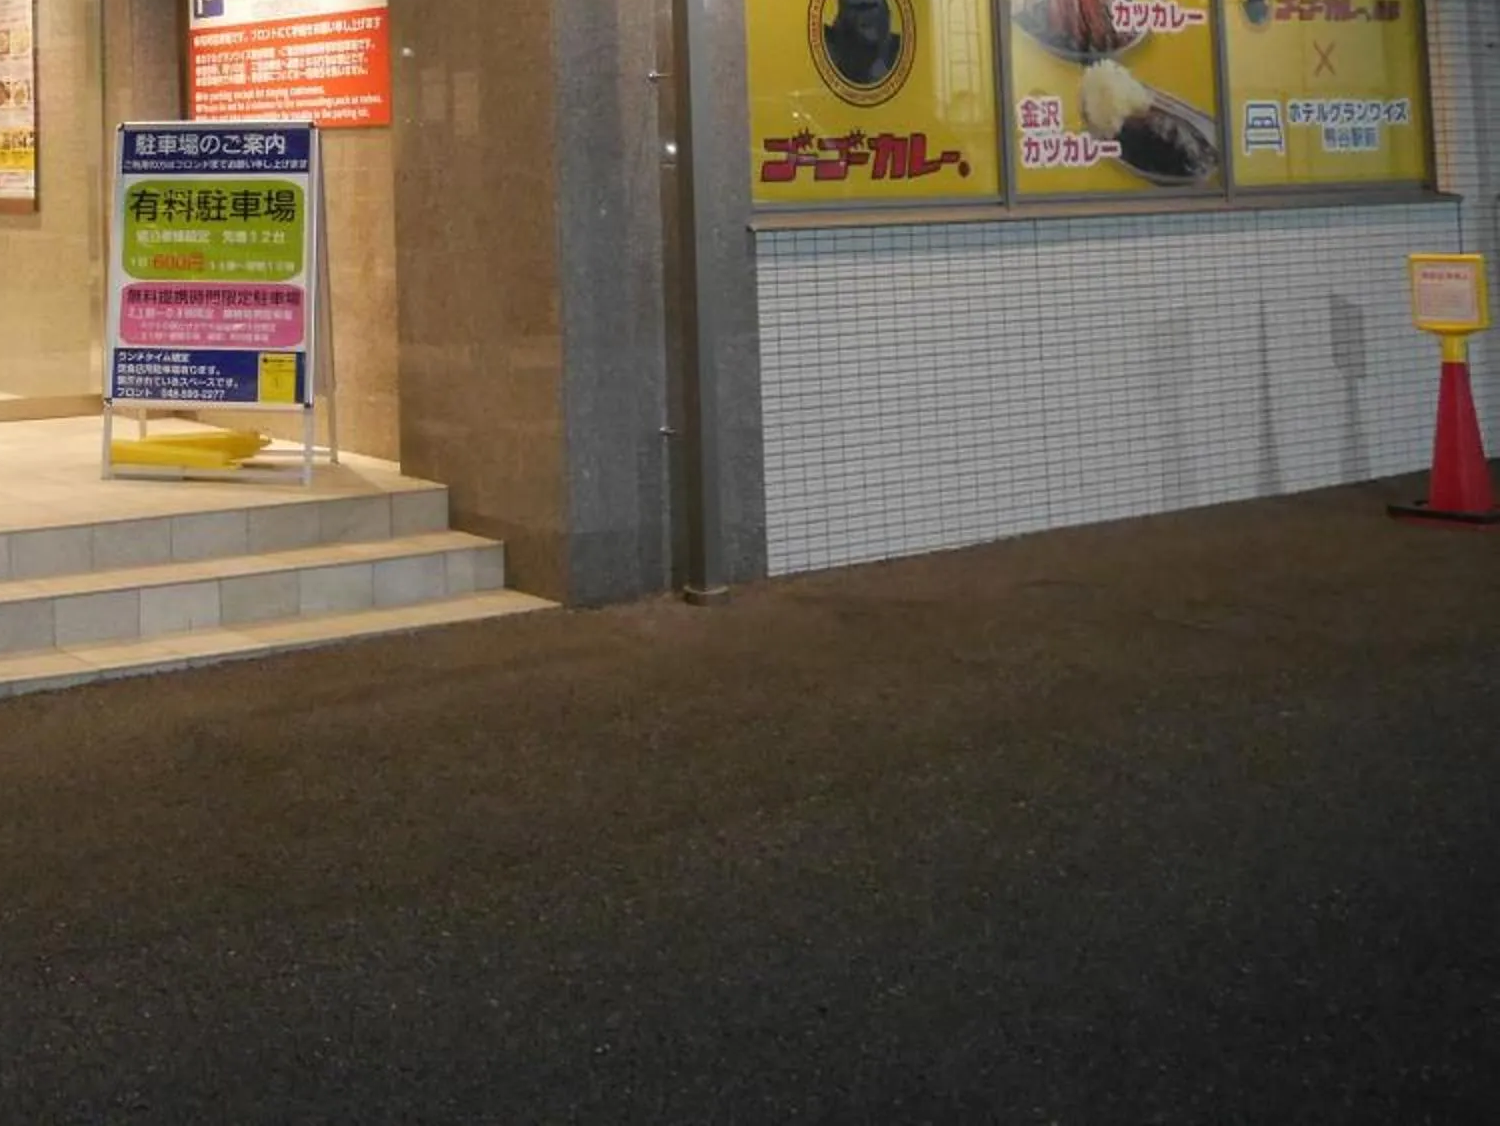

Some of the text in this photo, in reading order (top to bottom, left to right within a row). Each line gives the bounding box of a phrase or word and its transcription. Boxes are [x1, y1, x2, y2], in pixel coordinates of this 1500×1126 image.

[1114, 3, 1203, 27] カツカレー
[1020, 99, 1060, 128] 金沢
[135, 133, 286, 155] 駐車場のご案内
[1023, 137, 1118, 163] カツカレー
[129, 188, 297, 223] 有料駐車場
